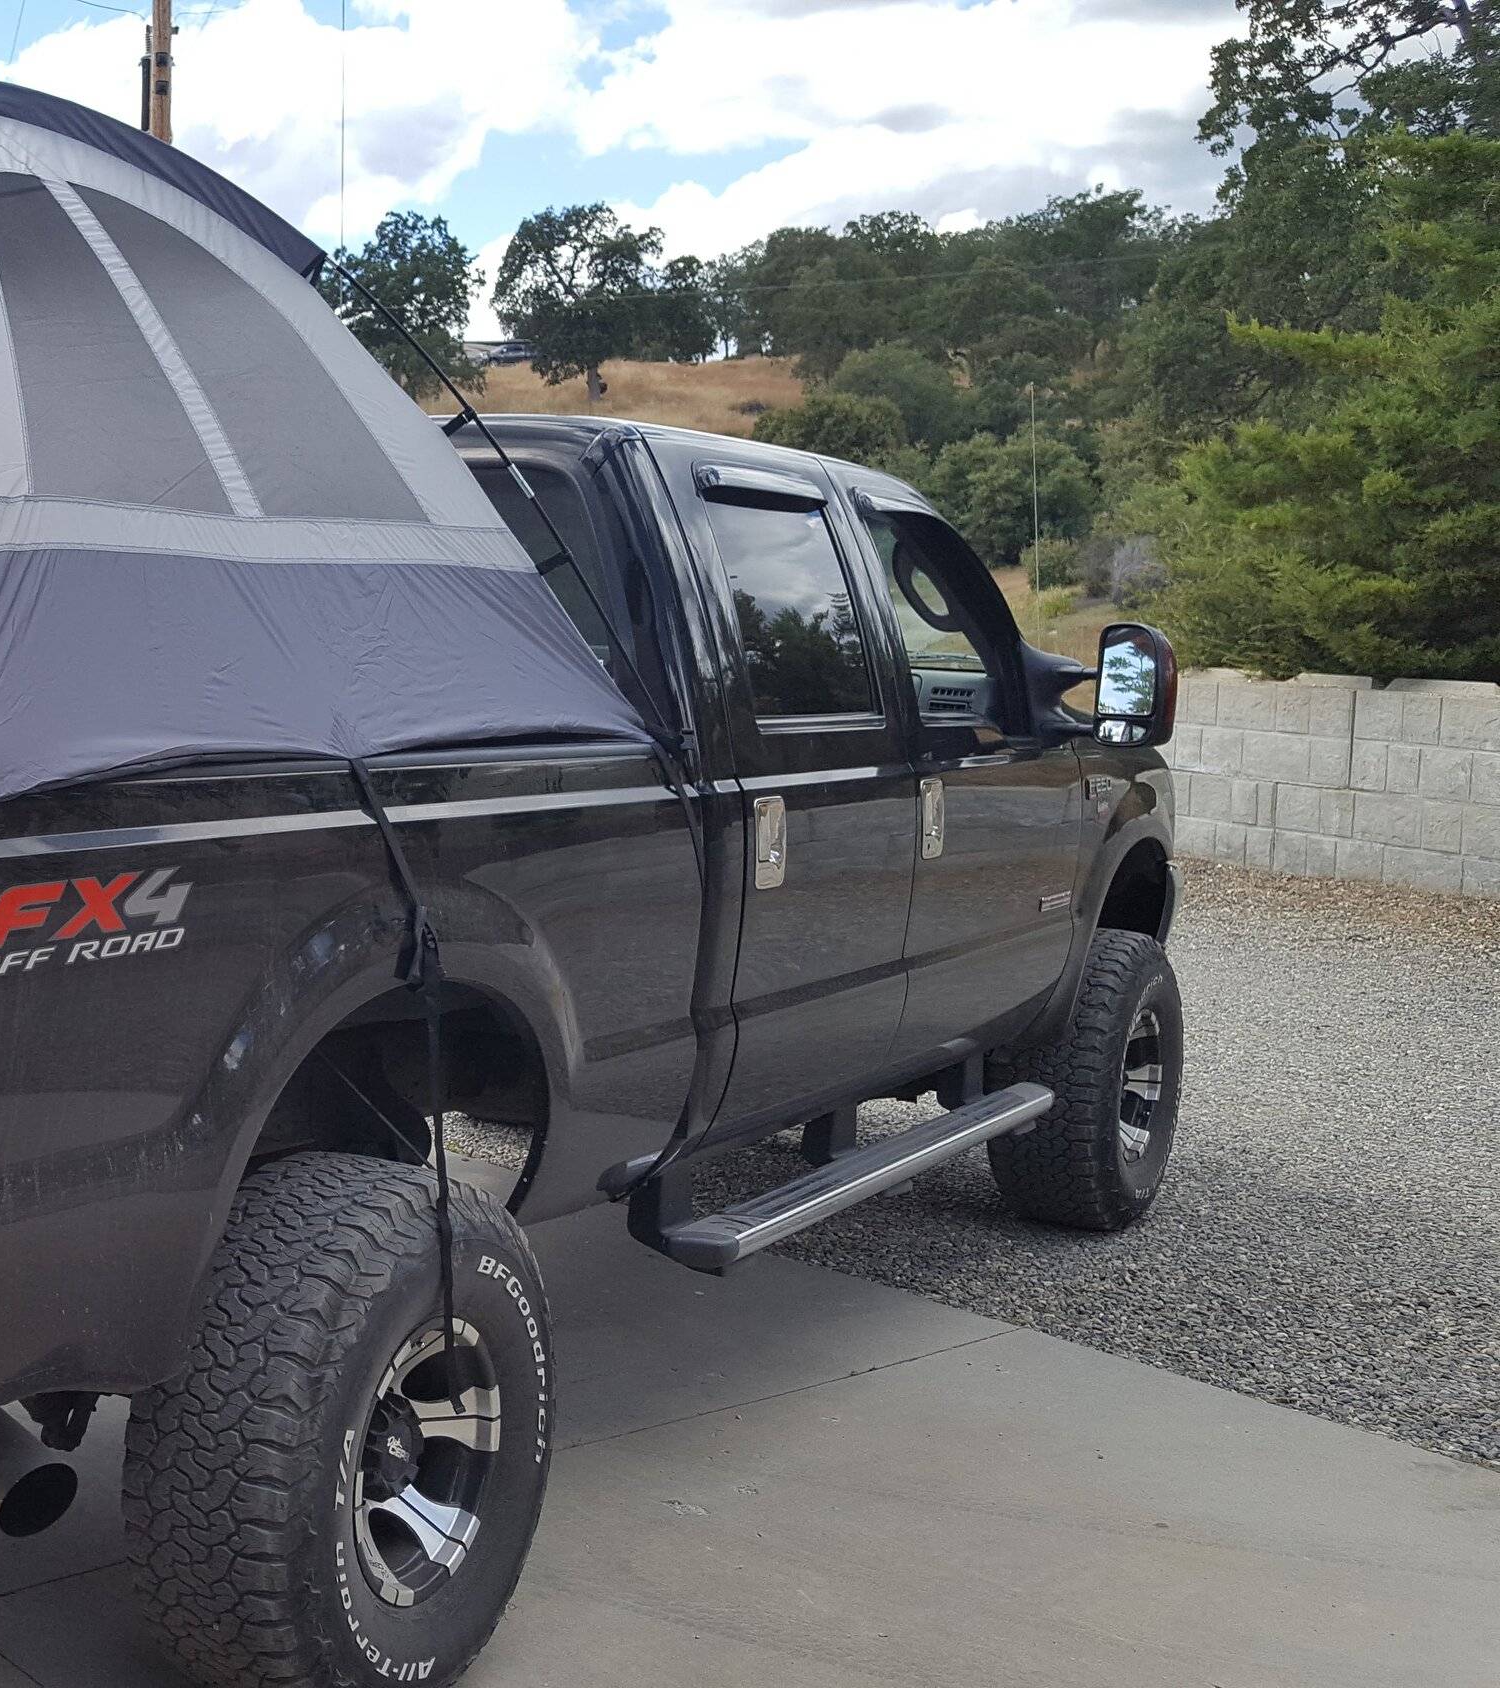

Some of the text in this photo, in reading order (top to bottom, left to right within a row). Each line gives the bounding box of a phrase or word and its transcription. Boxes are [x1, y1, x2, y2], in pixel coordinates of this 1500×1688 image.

[65, 928, 185, 964] ROAD
[477, 1255, 548, 1464] BFGoodrich
[334, 1430, 356, 1511] T/A
[336, 1541, 436, 1681] All-Terrain
